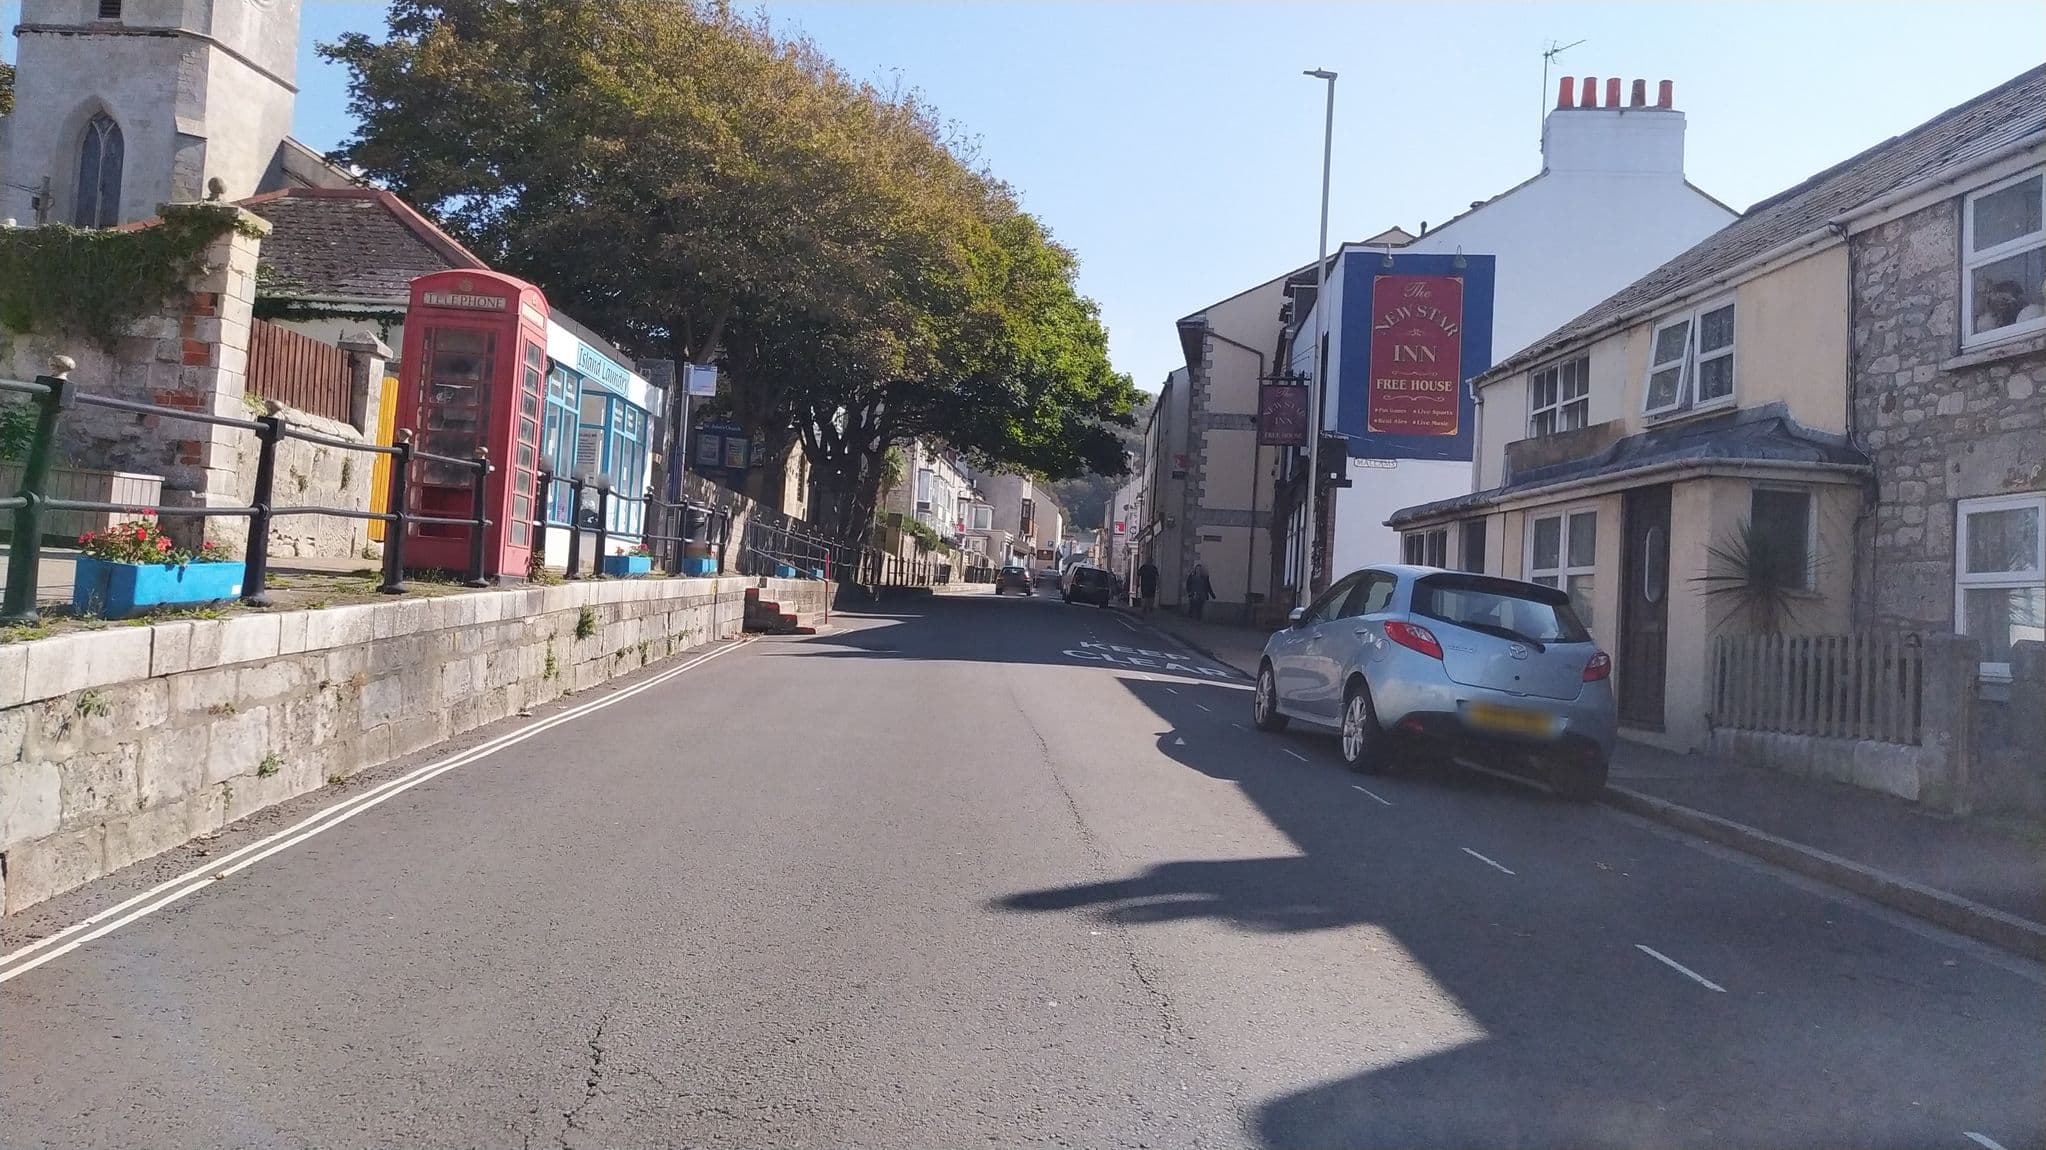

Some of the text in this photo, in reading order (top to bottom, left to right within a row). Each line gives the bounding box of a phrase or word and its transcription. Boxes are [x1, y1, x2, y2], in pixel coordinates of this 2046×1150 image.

[1404, 281, 1432, 298] The
[427, 292, 504, 309] TELEPHONE
[1375, 304, 1458, 338] NEW STAR
[1393, 344, 1436, 363] INN
[578, 347, 601, 377] Island
[601, 362, 627, 396] Laundry
[1376, 379, 1453, 392] FREE HOUSE
[1080, 641, 1190, 660] KEEP
[1062, 649, 1233, 679] CLEAR
